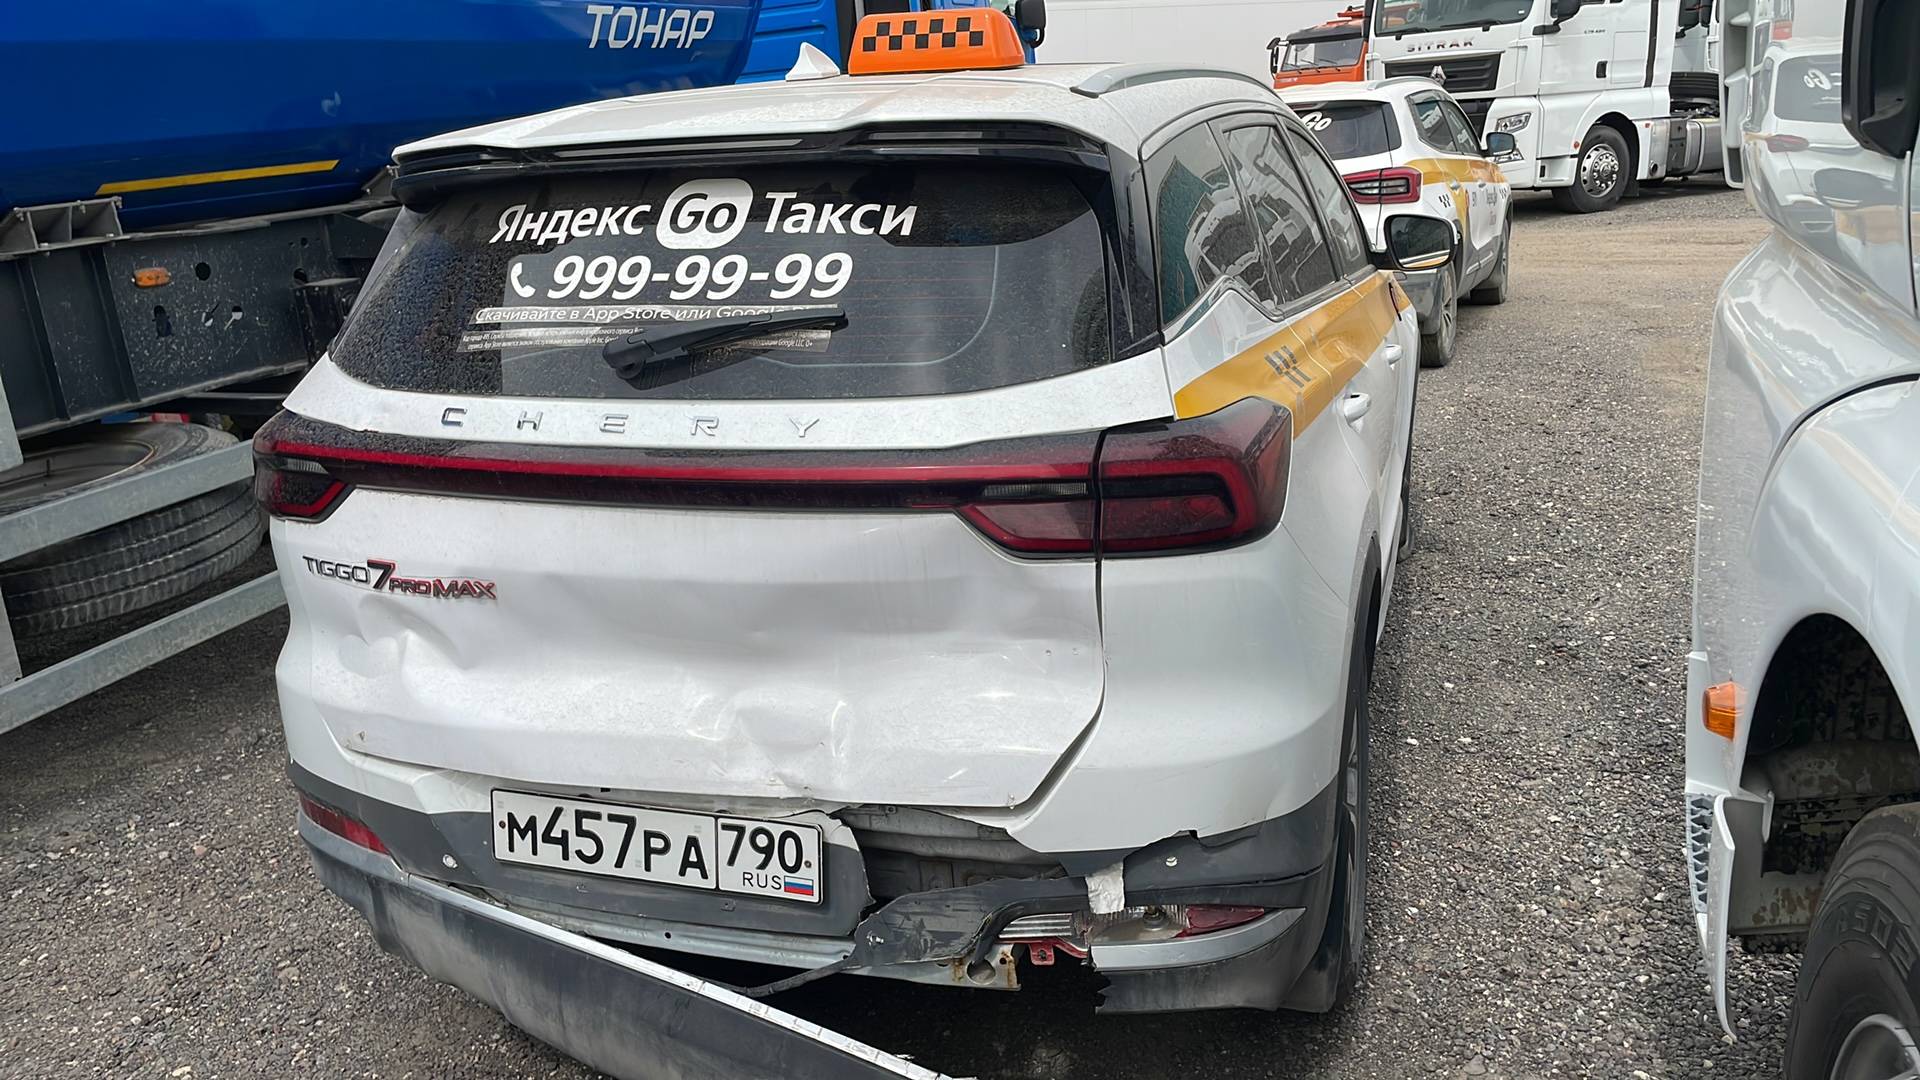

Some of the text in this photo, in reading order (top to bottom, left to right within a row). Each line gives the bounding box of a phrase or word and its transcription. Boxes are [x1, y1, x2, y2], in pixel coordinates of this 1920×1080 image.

[587, 5, 715, 48] ТОНАР
[1407, 37, 1475, 52] SITRAK
[489, 191, 918, 245] Яндекс Go Такси
[546, 252, 854, 300] 999-99-99
[475, 308, 567, 322] Скачивайте
[570, 311, 579, 320] в
[583, 308, 620, 322] App
[623, 307, 670, 320] Store
[675, 308, 711, 319] или
[440, 407, 820, 438] CHERY
[720, 823, 804, 874] 790
[742, 872, 782, 890] RUS
